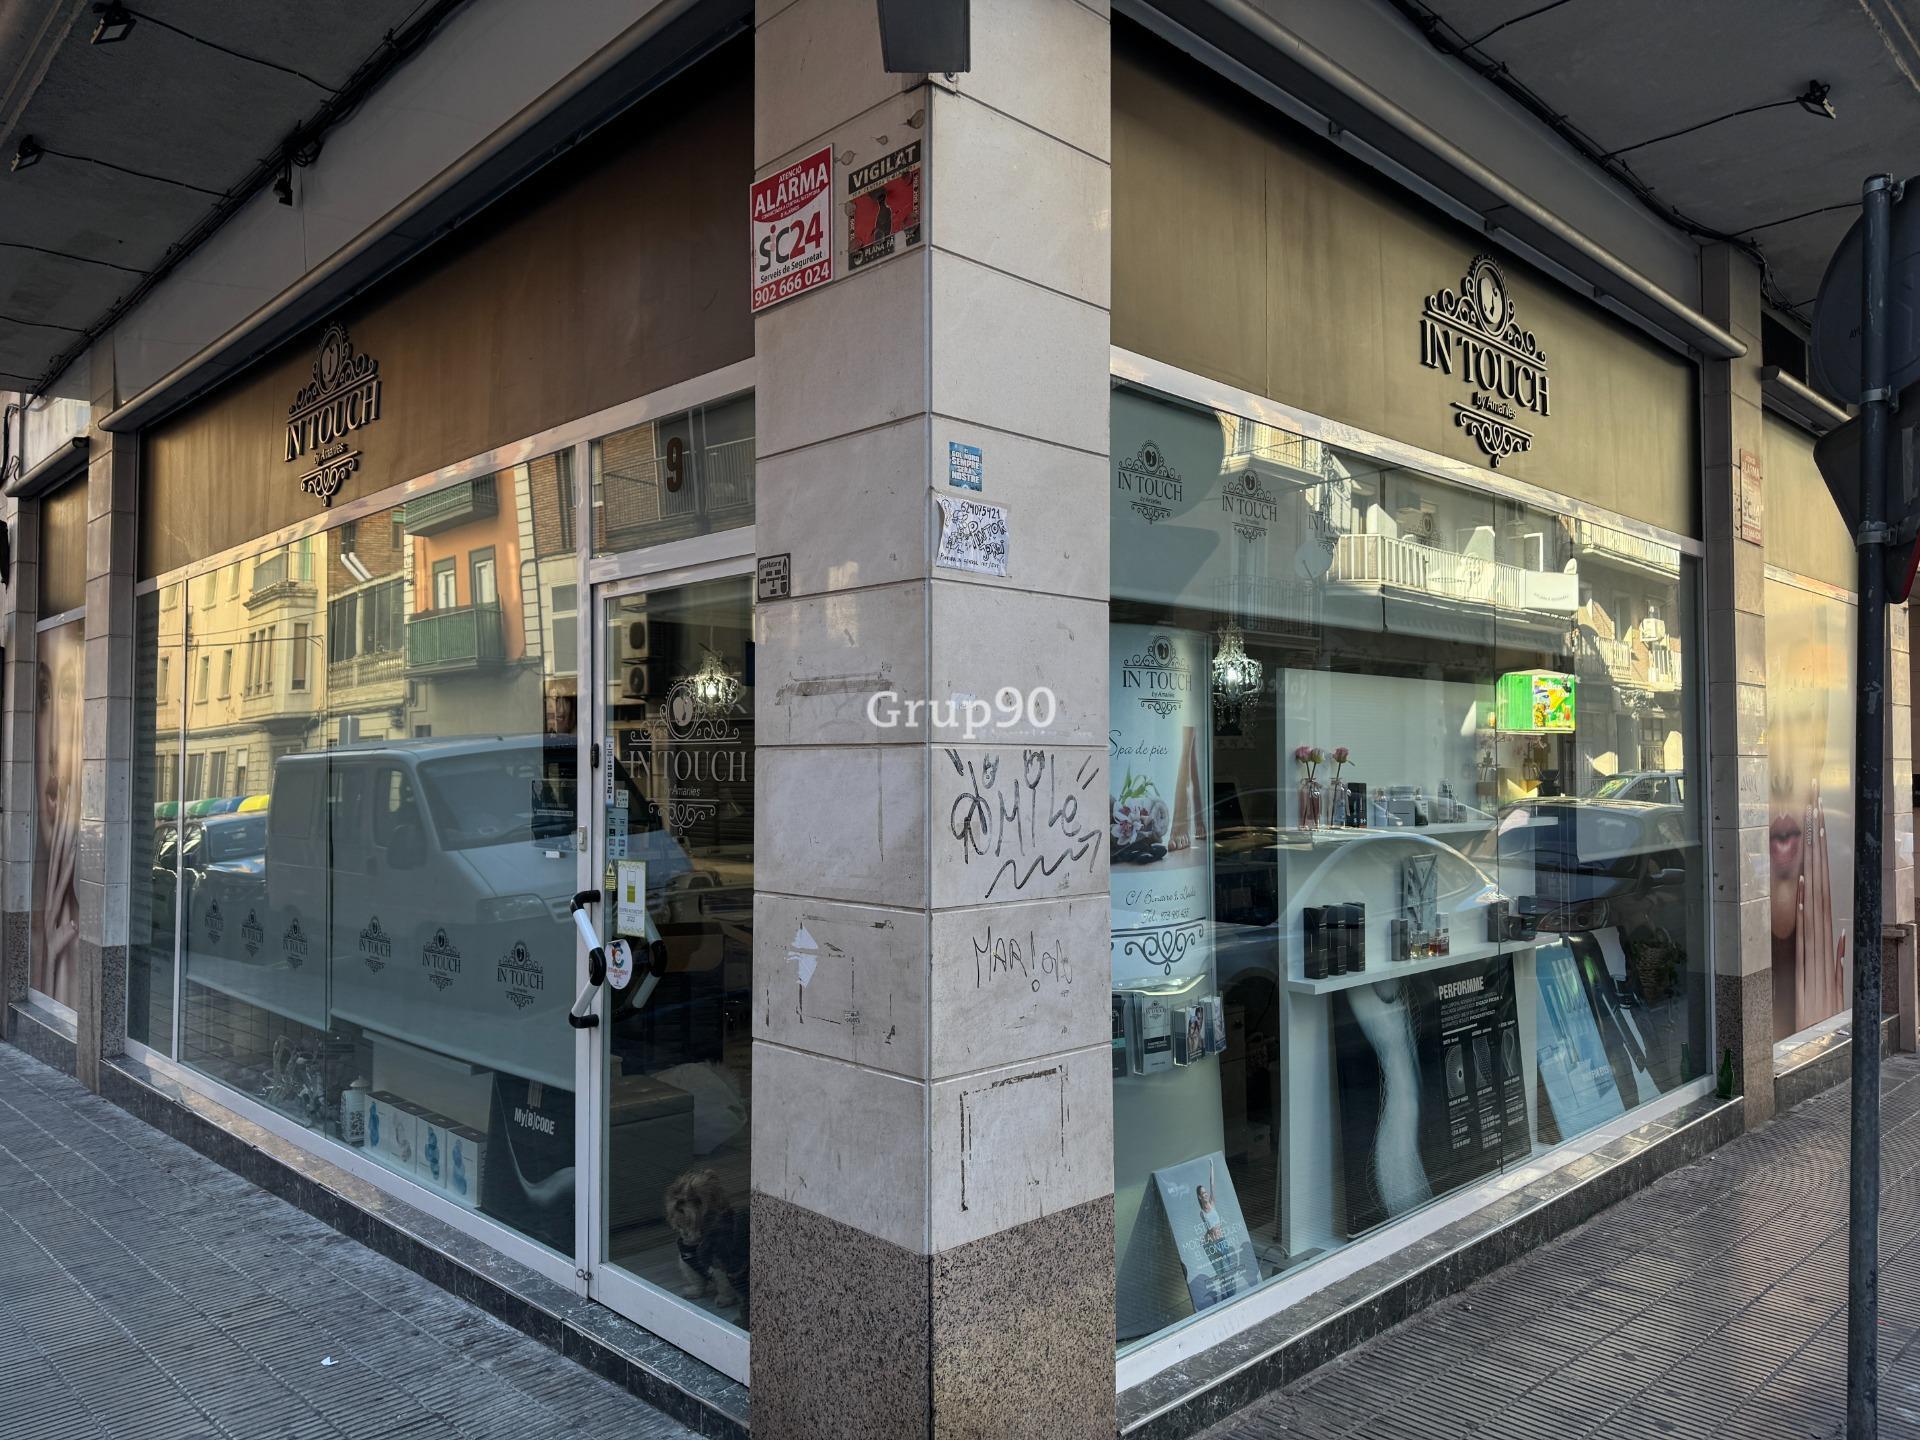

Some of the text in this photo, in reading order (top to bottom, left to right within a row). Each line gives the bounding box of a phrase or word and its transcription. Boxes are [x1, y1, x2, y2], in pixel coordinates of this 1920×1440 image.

[853, 145, 916, 188] VIGILAT
[754, 162, 829, 218] ALARMA
[760, 250, 823, 284] Serveis de Seguretat
[754, 261, 830, 307] 902 666 024
[1420, 319, 1551, 416] IN TOUCH
[1475, 393, 1486, 409] by
[284, 380, 382, 462] IN TOUCH
[666, 436, 683, 493] 9
[951, 457, 980, 470] SEMPRE
[951, 470, 980, 484] NOSTRE
[1118, 471, 1132, 492] IN
[1137, 475, 1183, 502] TOUCH
[1222, 494, 1234, 514] IN
[1238, 498, 1278, 522] TOUCH
[1122, 669, 1192, 692] IN TOUCH
[1109, 729, 1134, 760] Spa
[628, 750, 651, 780] IN
[657, 750, 748, 782] TOUCH
[422, 952, 430, 967] IN
[431, 954, 461, 973] TOUCH
[497, 967, 507, 983] IN
[509, 970, 544, 990] TOUCH
[1438, 976, 1485, 1000] PERFORMME
